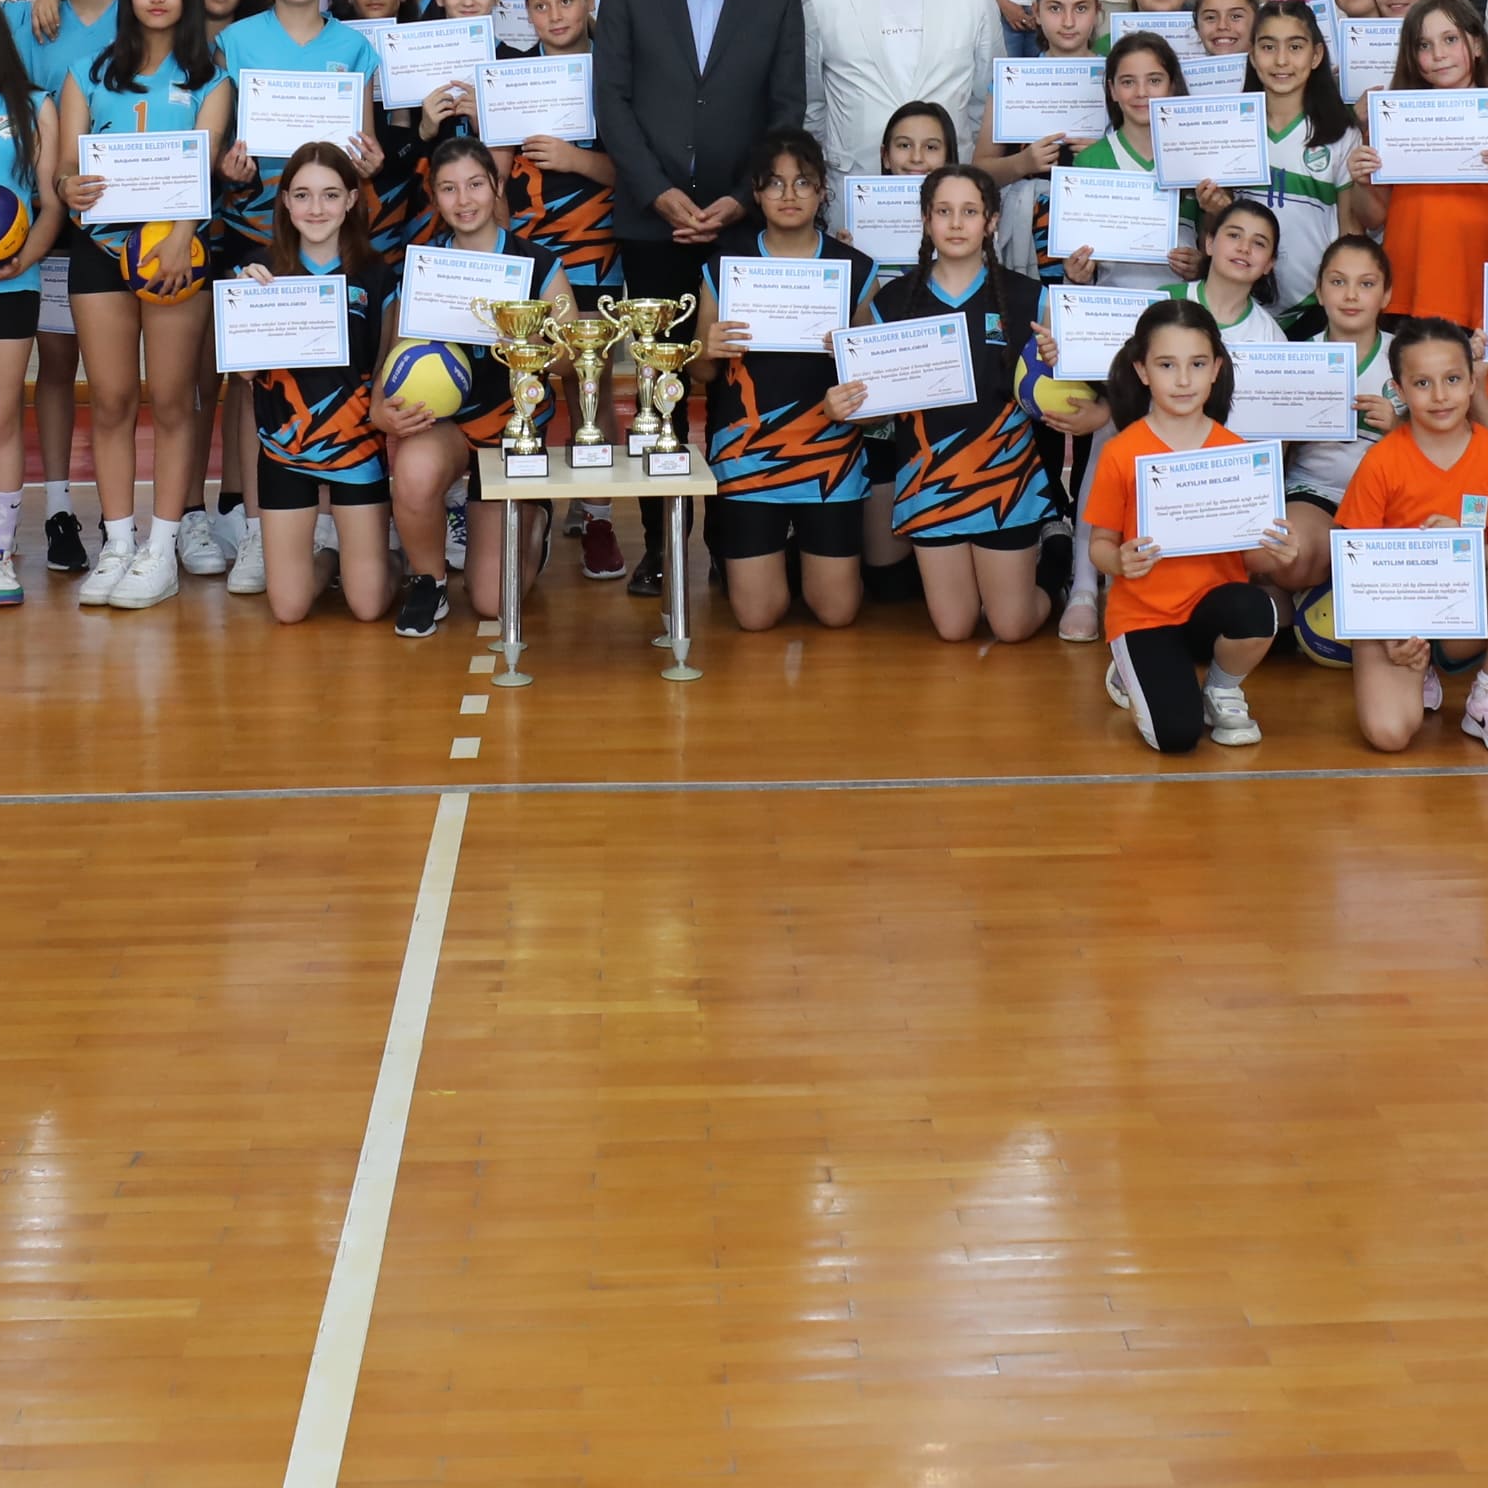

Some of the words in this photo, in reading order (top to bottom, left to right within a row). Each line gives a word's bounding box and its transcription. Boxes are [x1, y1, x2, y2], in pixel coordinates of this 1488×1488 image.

[133, 99, 149, 134] 1
[863, 332, 899, 345] NARLIDERE
[1170, 459, 1208, 473] NARLIDERE
[1176, 479, 1206, 488] KATILIM
[1366, 541, 1406, 550] NARLIDERE
